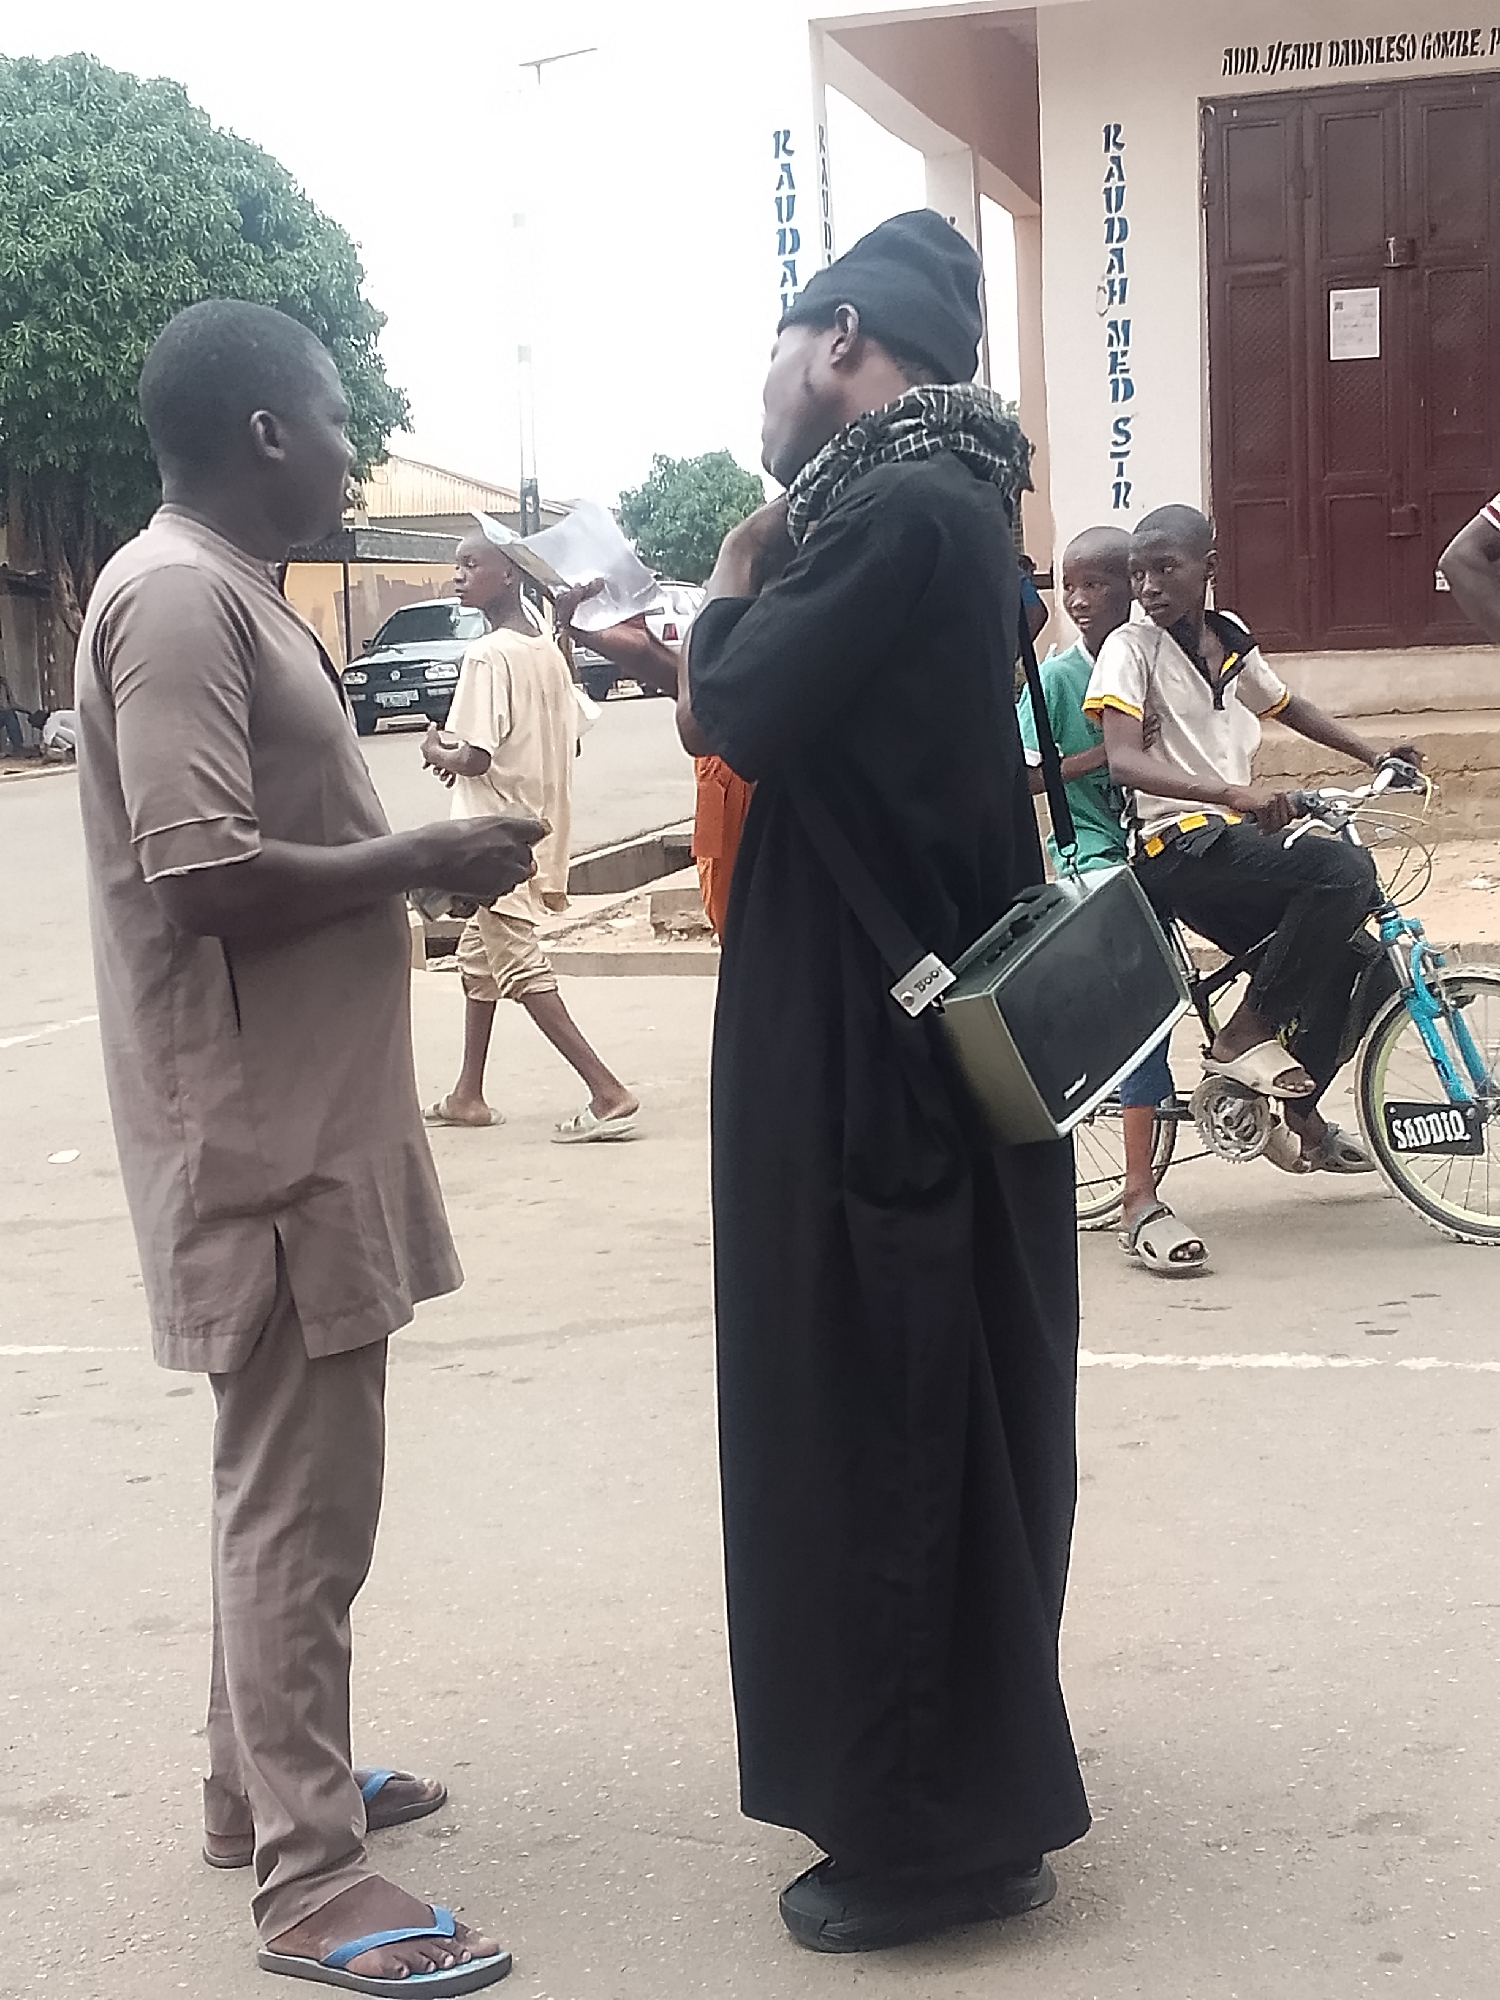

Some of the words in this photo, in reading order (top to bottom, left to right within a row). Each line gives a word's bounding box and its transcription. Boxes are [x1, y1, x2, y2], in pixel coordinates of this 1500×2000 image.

[1421, 28, 1485, 60] GOMBE.
[1102, 123, 1129, 306] RAUDAH
[1107, 319, 1135, 403] MED
[1110, 416, 1132, 509] STR
